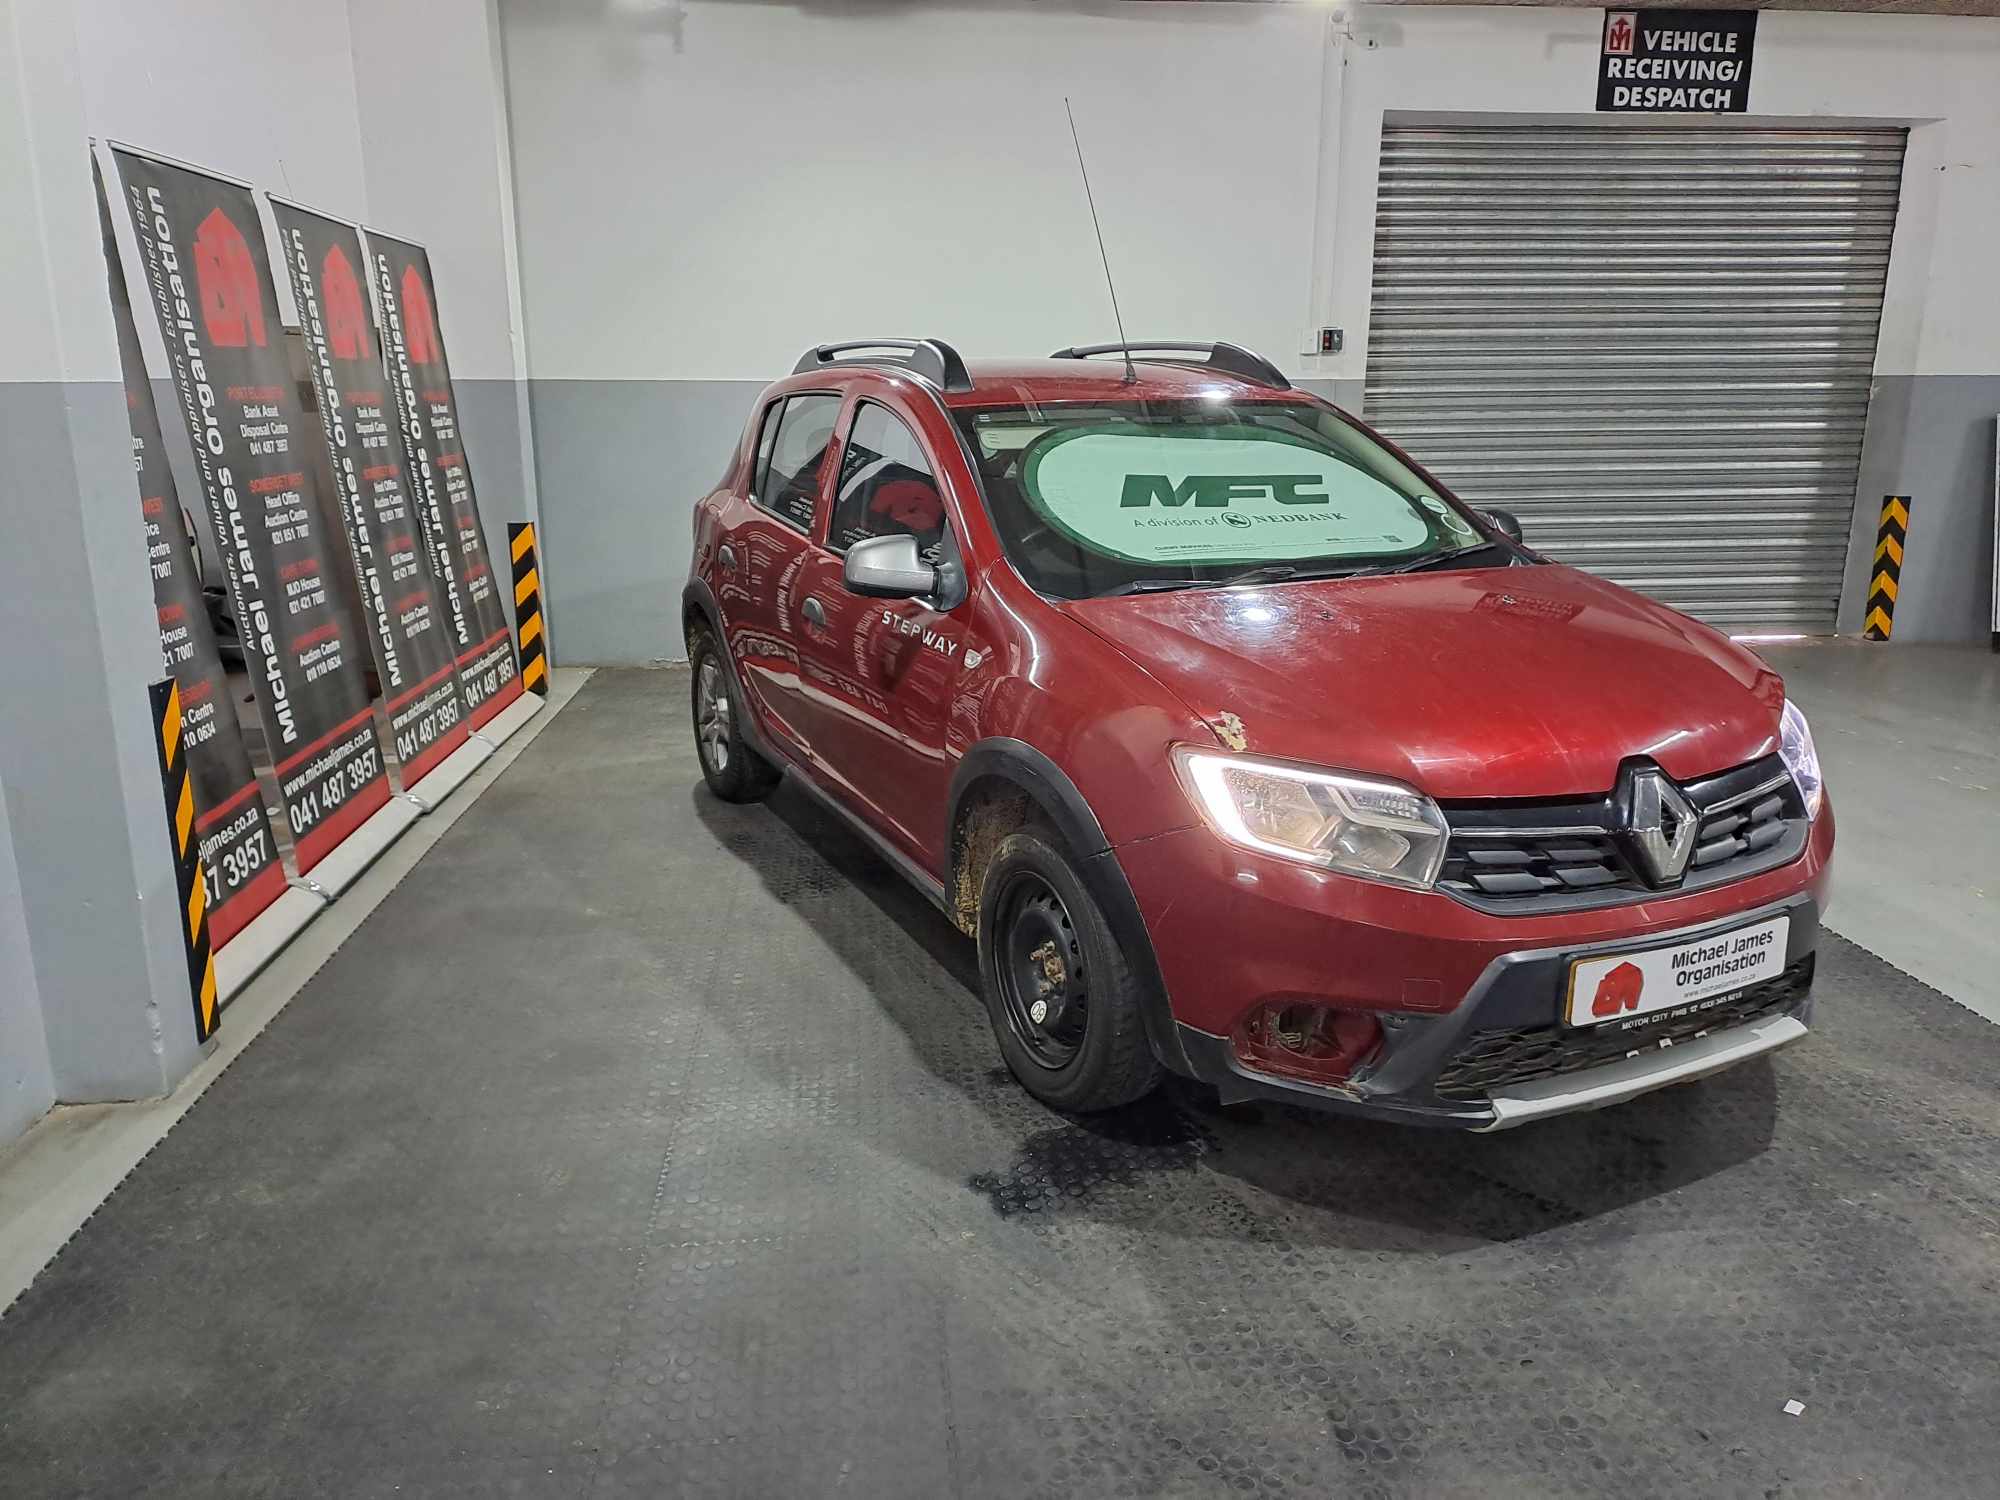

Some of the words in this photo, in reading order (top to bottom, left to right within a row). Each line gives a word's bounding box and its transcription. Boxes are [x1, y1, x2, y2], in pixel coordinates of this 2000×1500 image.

[1643, 30, 1738, 53] VEHICLE
[1607, 58, 1743, 82] RECEIVING/
[1612, 86, 1732, 109] DESPATCH
[130, 184, 150, 231] 1964
[142, 235, 176, 338] Established
[147, 187, 224, 455] Organisation
[292, 229, 347, 448] Organisation
[378, 254, 422, 440] Organisation
[175, 353, 203, 445] Appraisers
[197, 447, 212, 481] and
[1120, 474, 1330, 508] MFC
[208, 486, 228, 545] Valuers
[342, 457, 373, 559] James
[417, 448, 444, 535] James
[1253, 512, 1348, 524] NEDBANK
[218, 467, 260, 589] James
[1134, 518, 1145, 528] A
[1147, 517, 1200, 528] division
[1201, 516, 1219, 526] of
[152, 561, 172, 580] 7007
[437, 542, 469, 645] Michael
[226, 552, 256, 650] Auctioneers,
[365, 567, 402, 687] Michael
[162, 653, 174, 667] 21
[175, 642, 194, 662] 7007
[881, 609, 958, 656] STEPWAY
[248, 600, 298, 744] Michael
[465, 679, 484, 708] 041
[484, 669, 497, 695] 487
[498, 656, 514, 684] 3957
[188, 702, 214, 724] Centre
[197, 720, 216, 743] 0634
[397, 728, 419, 761] 041
[419, 712, 437, 744] 487
[437, 697, 459, 731] 3957
[290, 791, 320, 833] 041
[322, 770, 345, 808] 487
[347, 747, 377, 790] 3957
[222, 829, 267, 886] 3957
[1671, 941, 1729, 969] Michael
[1731, 929, 1774, 954] James
[1676, 950, 1766, 987] Organisation
